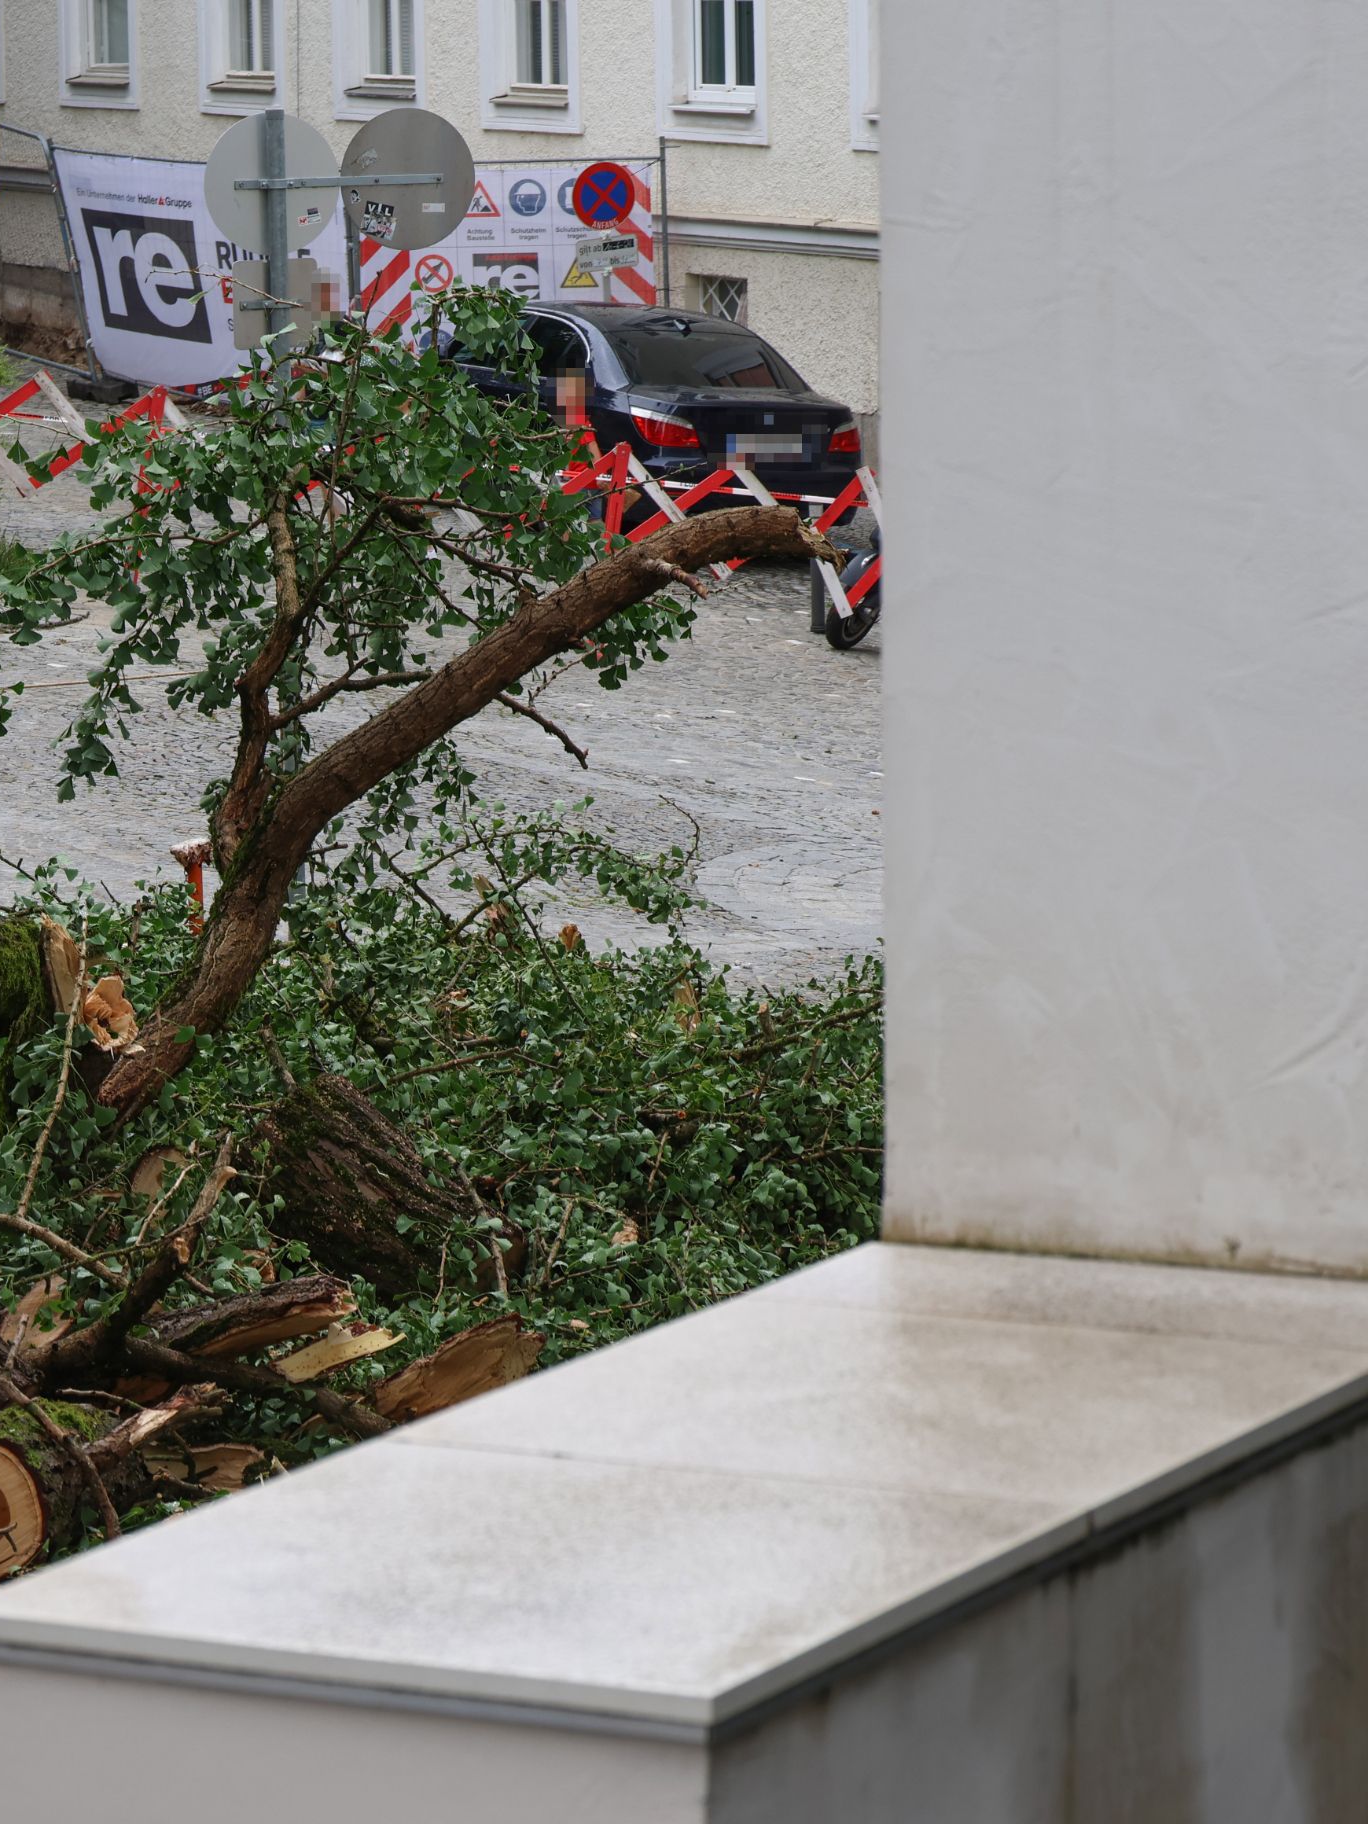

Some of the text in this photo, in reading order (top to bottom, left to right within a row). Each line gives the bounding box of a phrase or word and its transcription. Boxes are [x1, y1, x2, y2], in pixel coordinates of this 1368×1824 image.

[591, 219, 620, 230] ANFANG
[467, 228, 493, 236] Achtung
[579, 245, 591, 256] gilt
[92, 226, 195, 328] re
[473, 264, 540, 299] re
